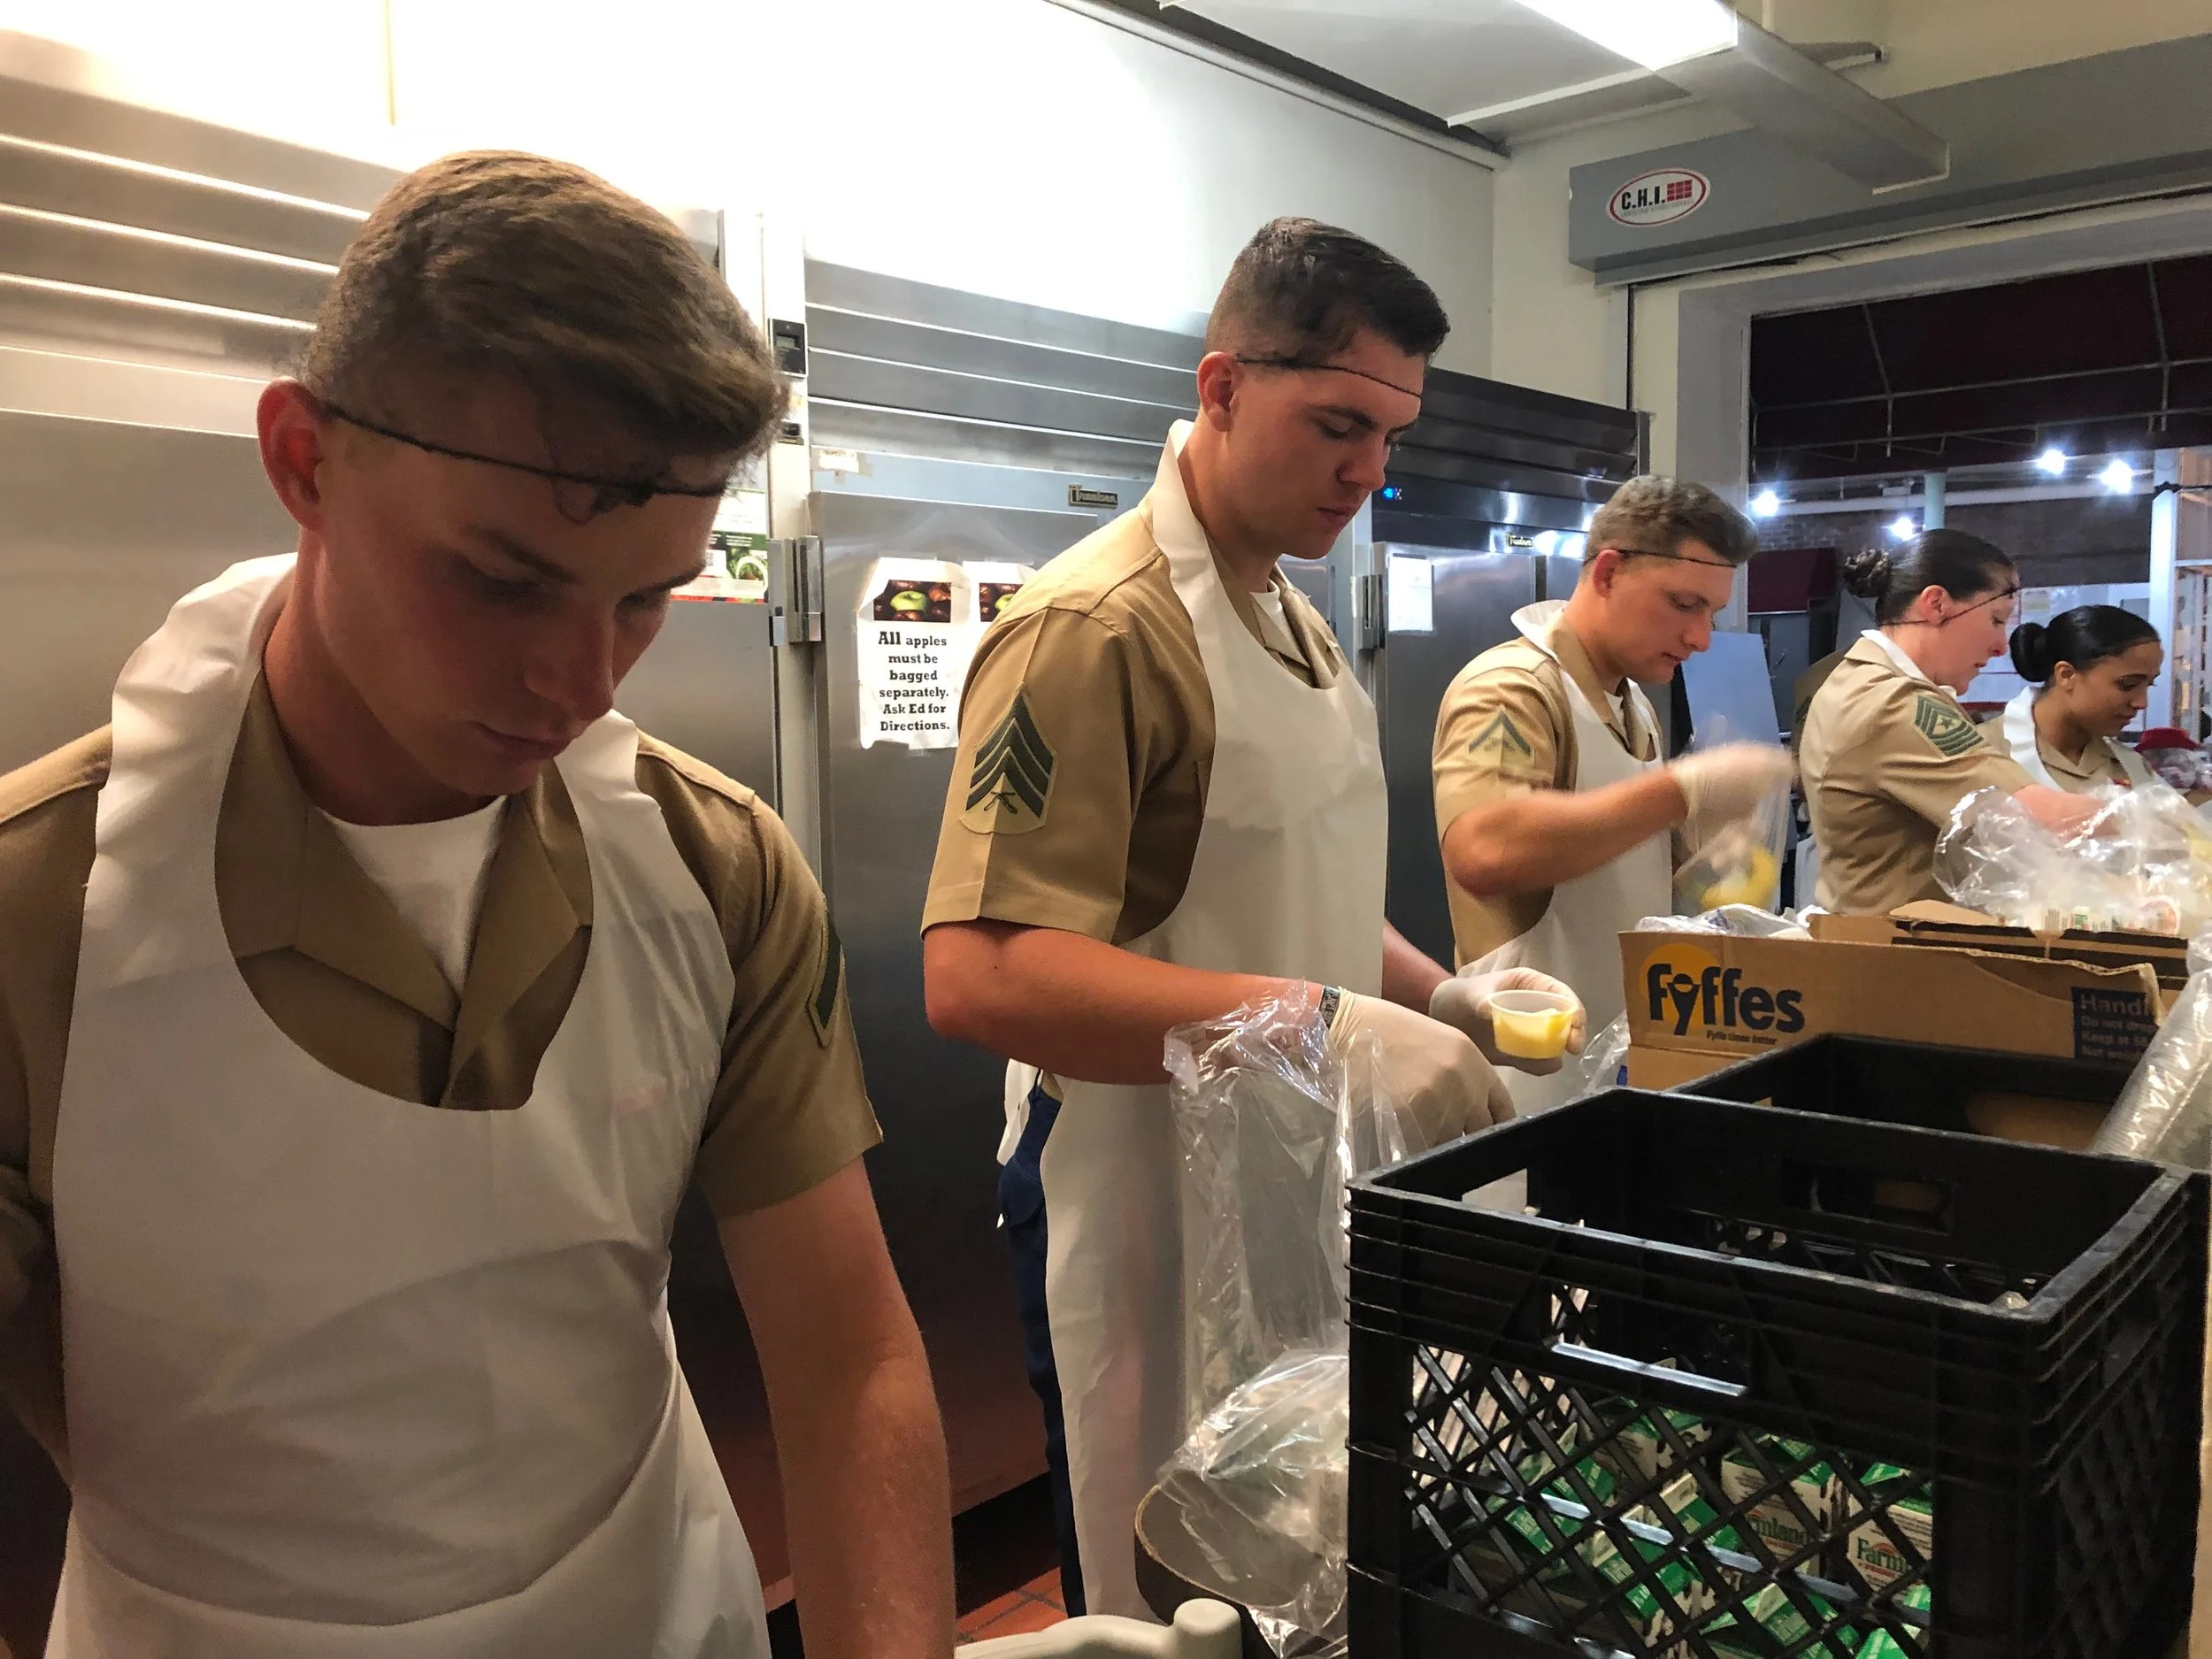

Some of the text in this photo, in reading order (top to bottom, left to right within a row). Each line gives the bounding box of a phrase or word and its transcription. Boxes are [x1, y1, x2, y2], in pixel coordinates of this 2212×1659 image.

[1621, 186, 1666, 211] C.H.I.
[878, 631, 948, 649] All apples
[887, 653, 938, 664] must be
[889, 669, 938, 684] bagged
[879, 686, 949, 701] separately.
[882, 703, 947, 715] Ask Ed for
[879, 719, 950, 732] Directions.
[1647, 963, 1805, 1037] Fyffes
